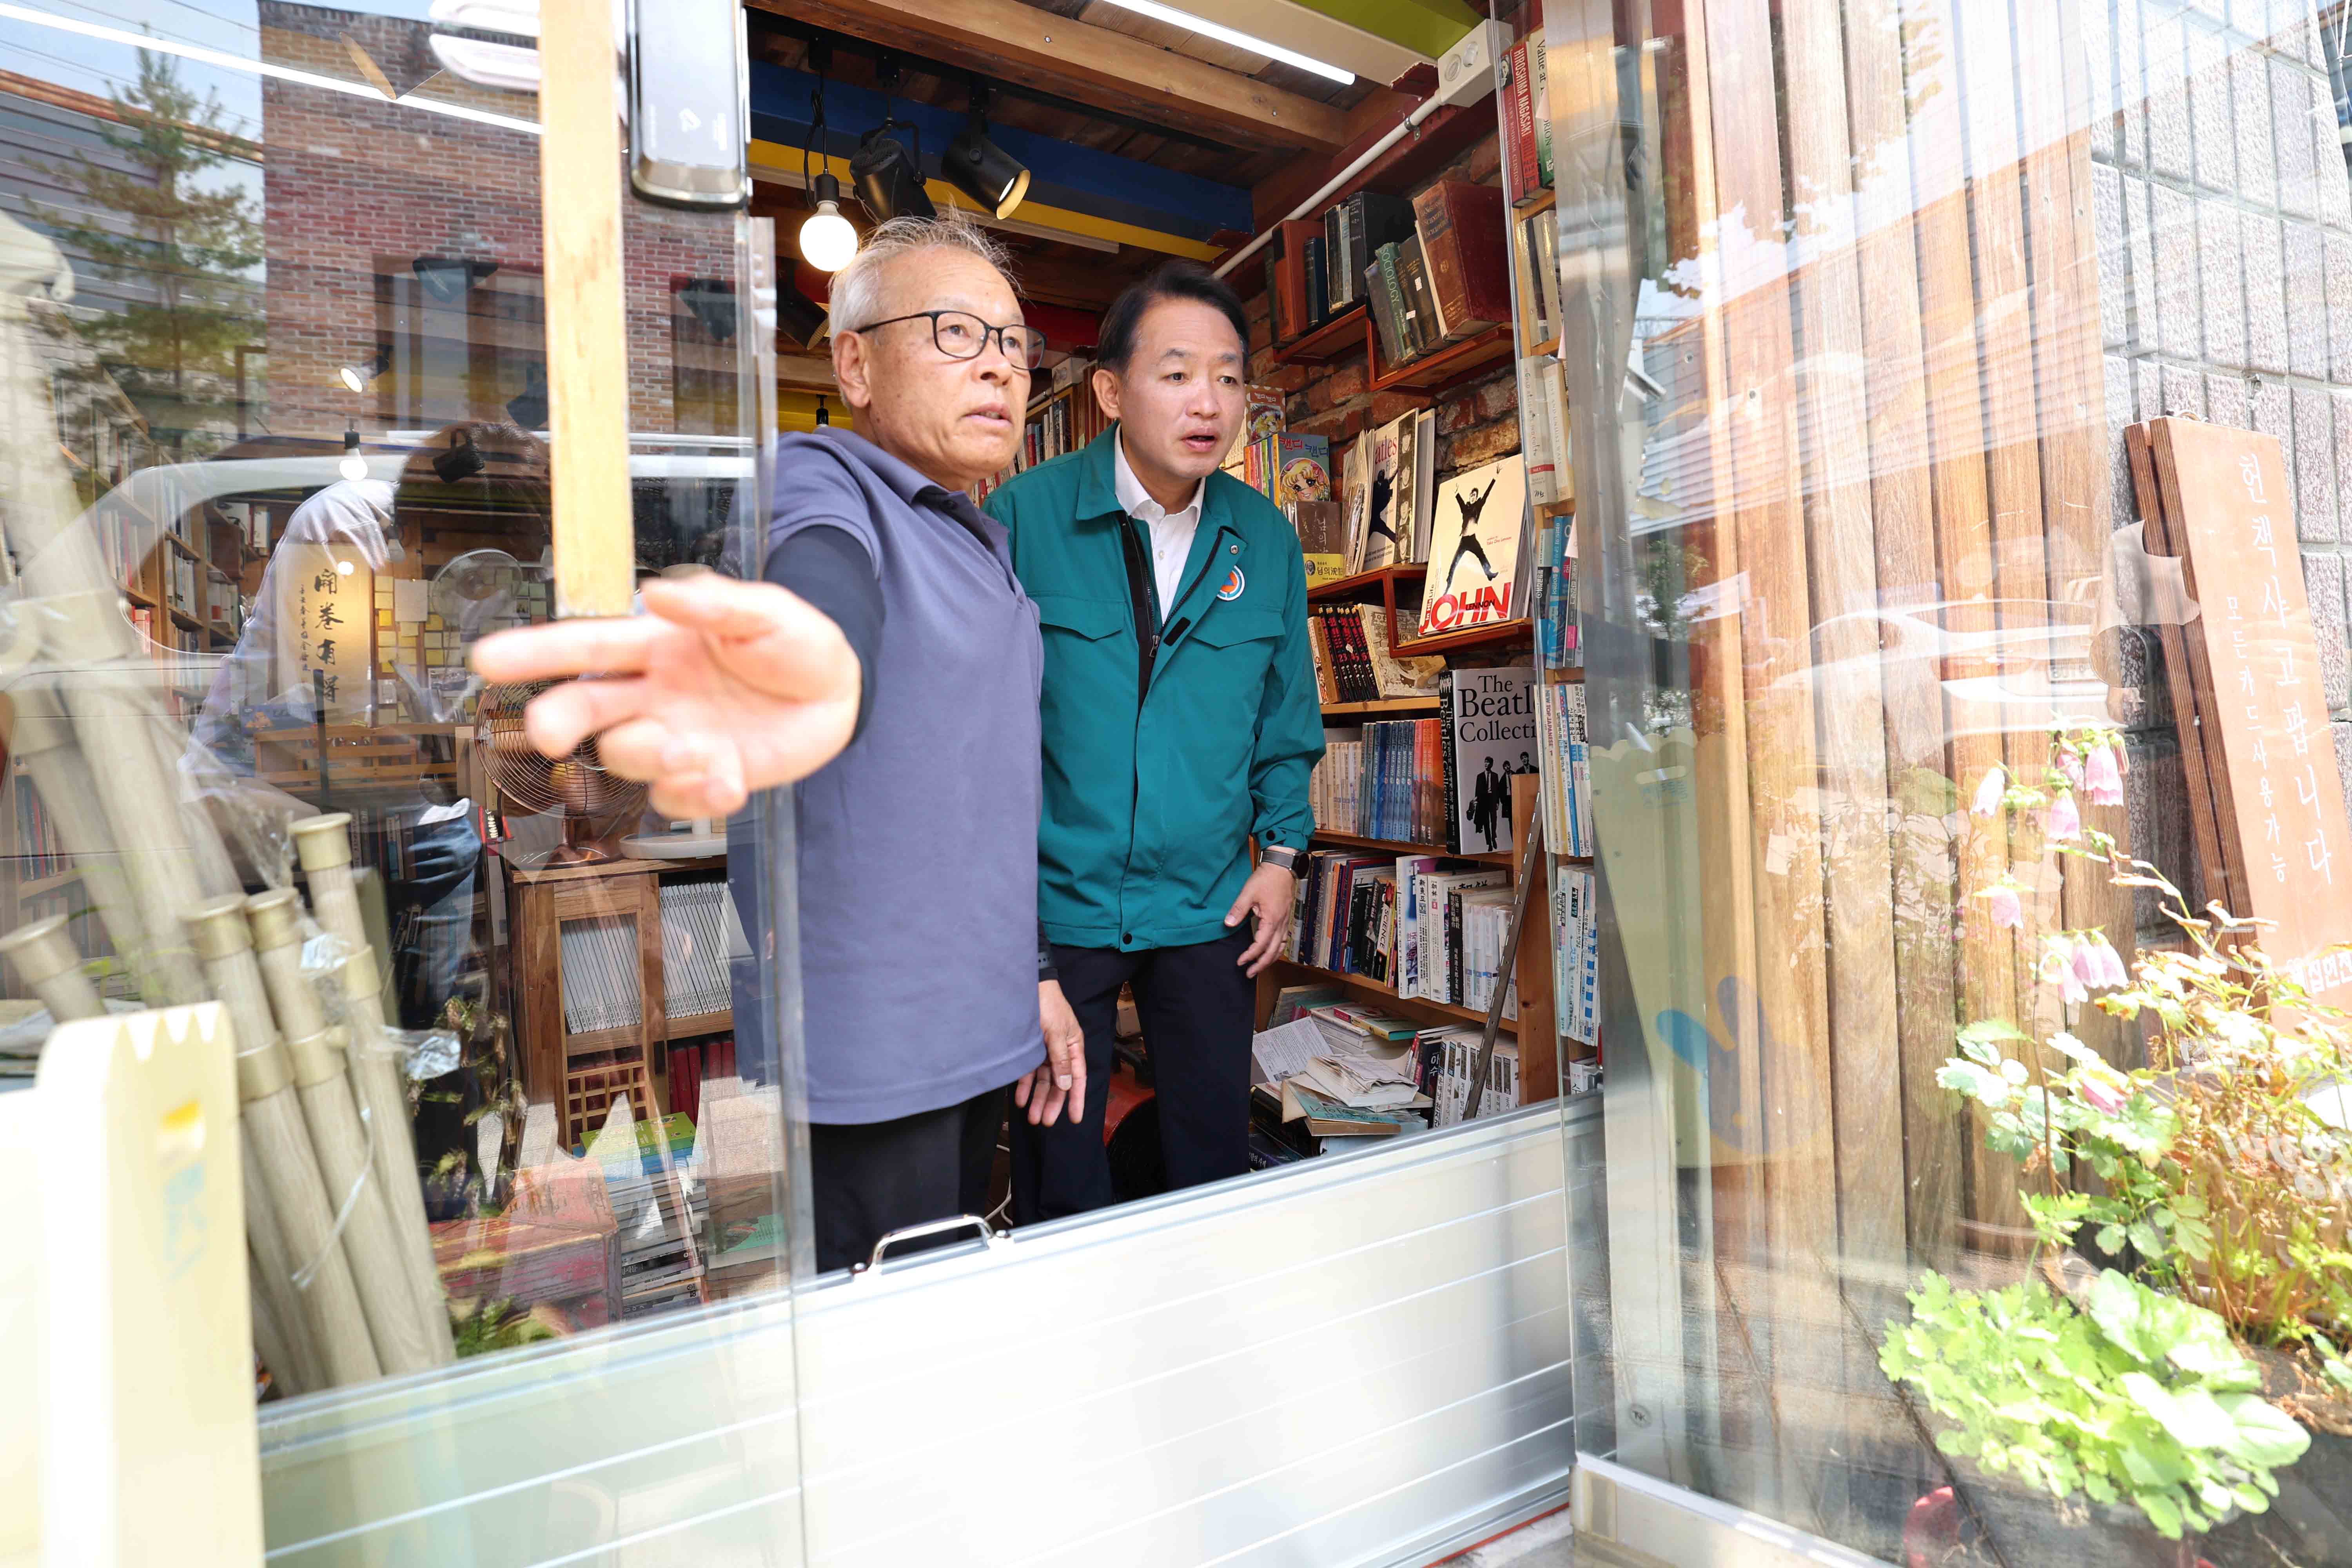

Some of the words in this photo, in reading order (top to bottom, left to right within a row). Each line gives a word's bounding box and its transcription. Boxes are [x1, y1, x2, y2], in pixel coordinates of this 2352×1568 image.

[1514, 47, 1528, 97] HIROSHIMA
[1518, 97, 1531, 136] NAGASAKI
[1279, 436, 1303, 450] 캔디
[1305, 444, 1329, 458] 캔디
[1375, 436, 1397, 465] atles
[1386, 457, 1397, 471] Files
[1419, 582, 1512, 635] JOHN
[1465, 599, 1495, 611] LENNON
[1477, 675, 1513, 693] The
[1458, 685, 1535, 717] Beatl
[1440, 697, 1449, 757] Beatles
[1445, 707, 1454, 728] The
[1460, 720, 1537, 742] Collecti
[1379, 908, 1388, 949] SCIENCE
